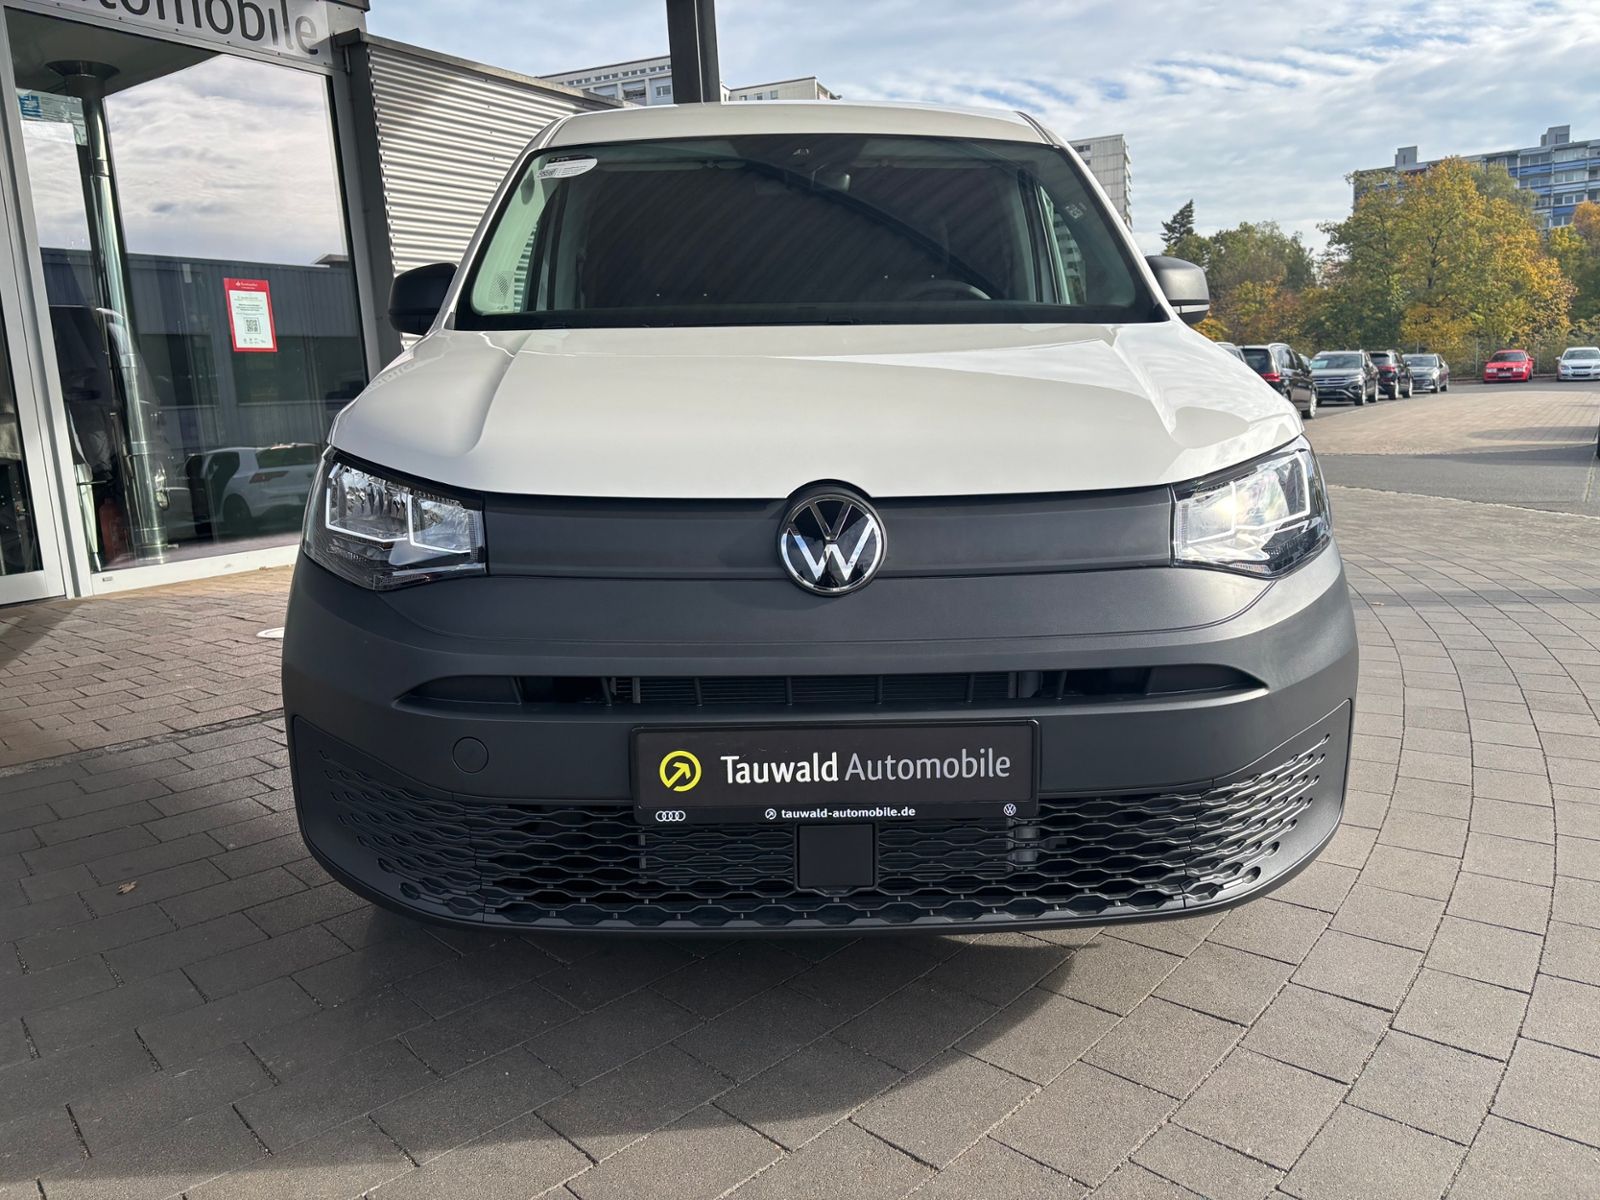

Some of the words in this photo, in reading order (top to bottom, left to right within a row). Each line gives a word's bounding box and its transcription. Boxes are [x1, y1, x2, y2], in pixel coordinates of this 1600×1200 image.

[720, 752, 839, 784] Tauwald
[844, 747, 1011, 781] Automobile
[780, 807, 916, 819] tauwald-automobile.de
